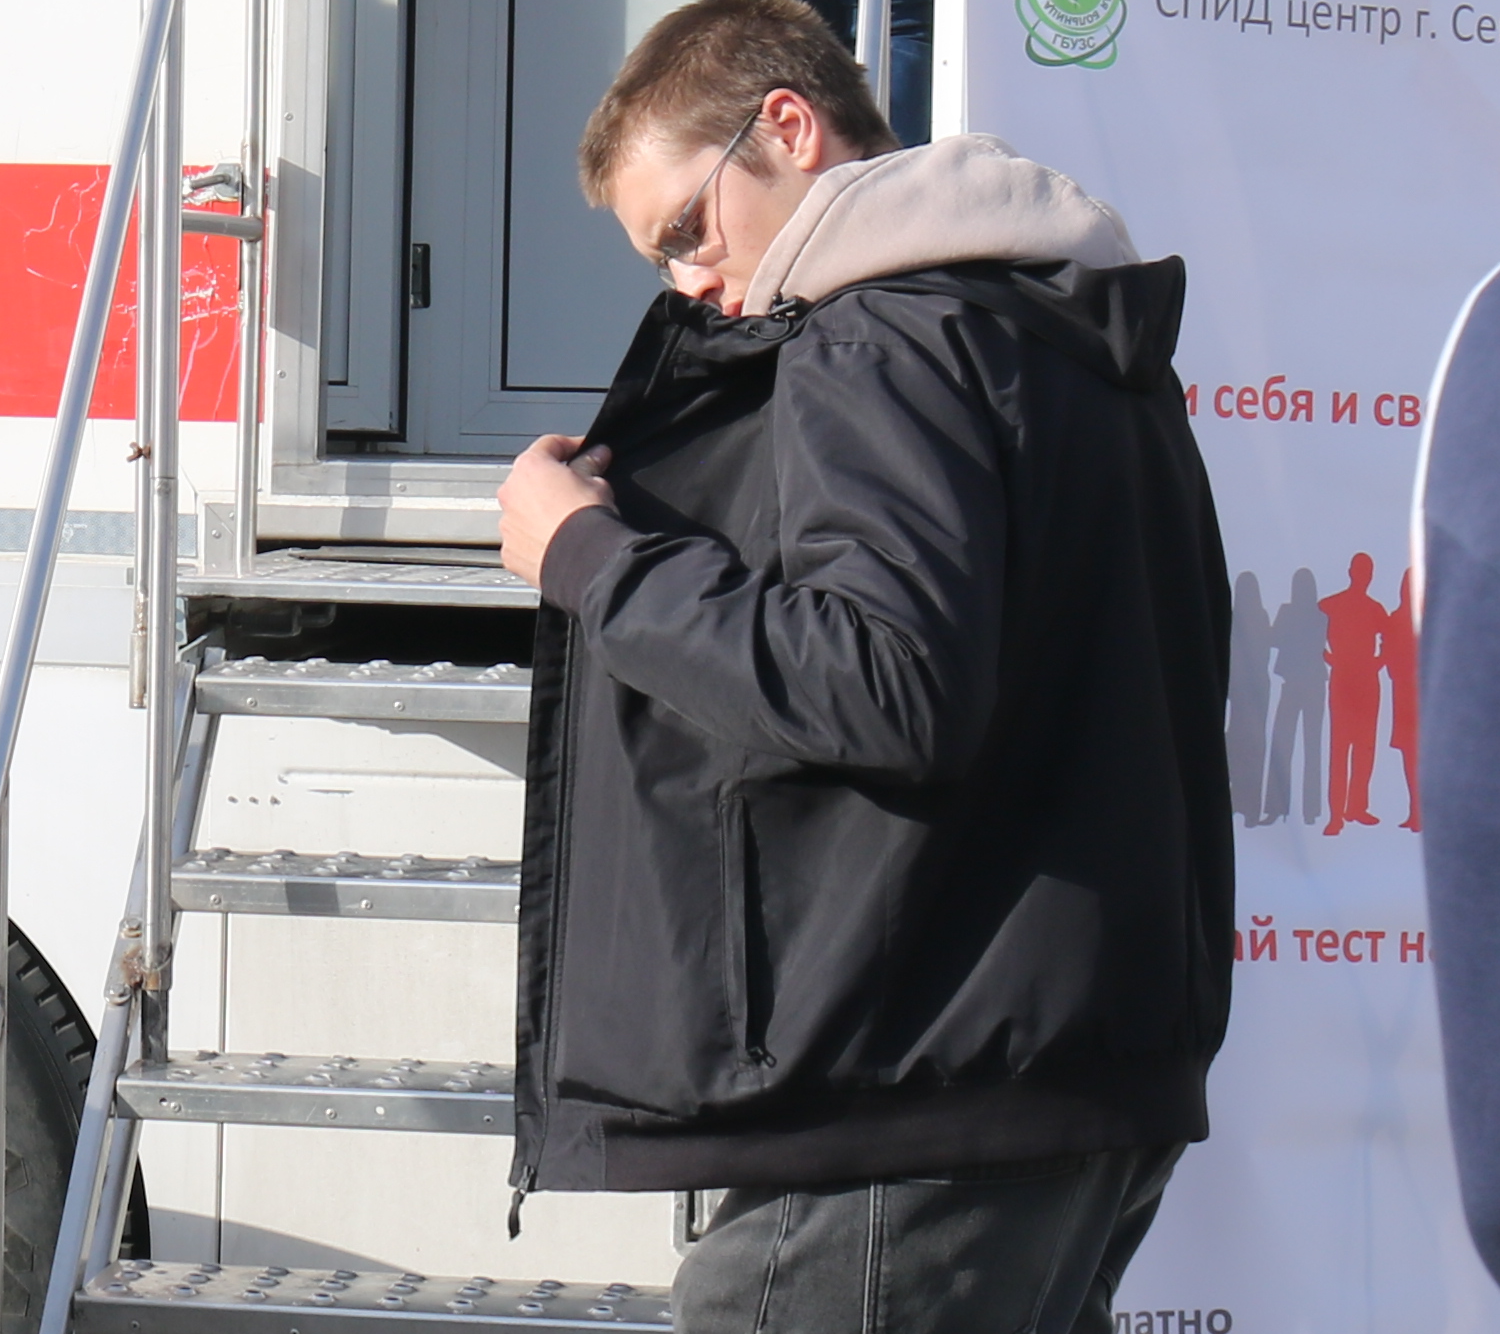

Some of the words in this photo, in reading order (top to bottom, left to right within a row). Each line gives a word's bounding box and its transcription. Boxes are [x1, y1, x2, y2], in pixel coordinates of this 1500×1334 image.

[1044, 1, 1100, 26] БОЛЬНИЦА
[1415, 9, 1438, 39] г.
[1052, 33, 1096, 51] ГБУЗС
[1213, 375, 1314, 423] себя
[1331, 391, 1358, 424] и
[1373, 394, 1422, 427] св
[1292, 930, 1386, 963] тест
[1399, 931, 1430, 963] н
